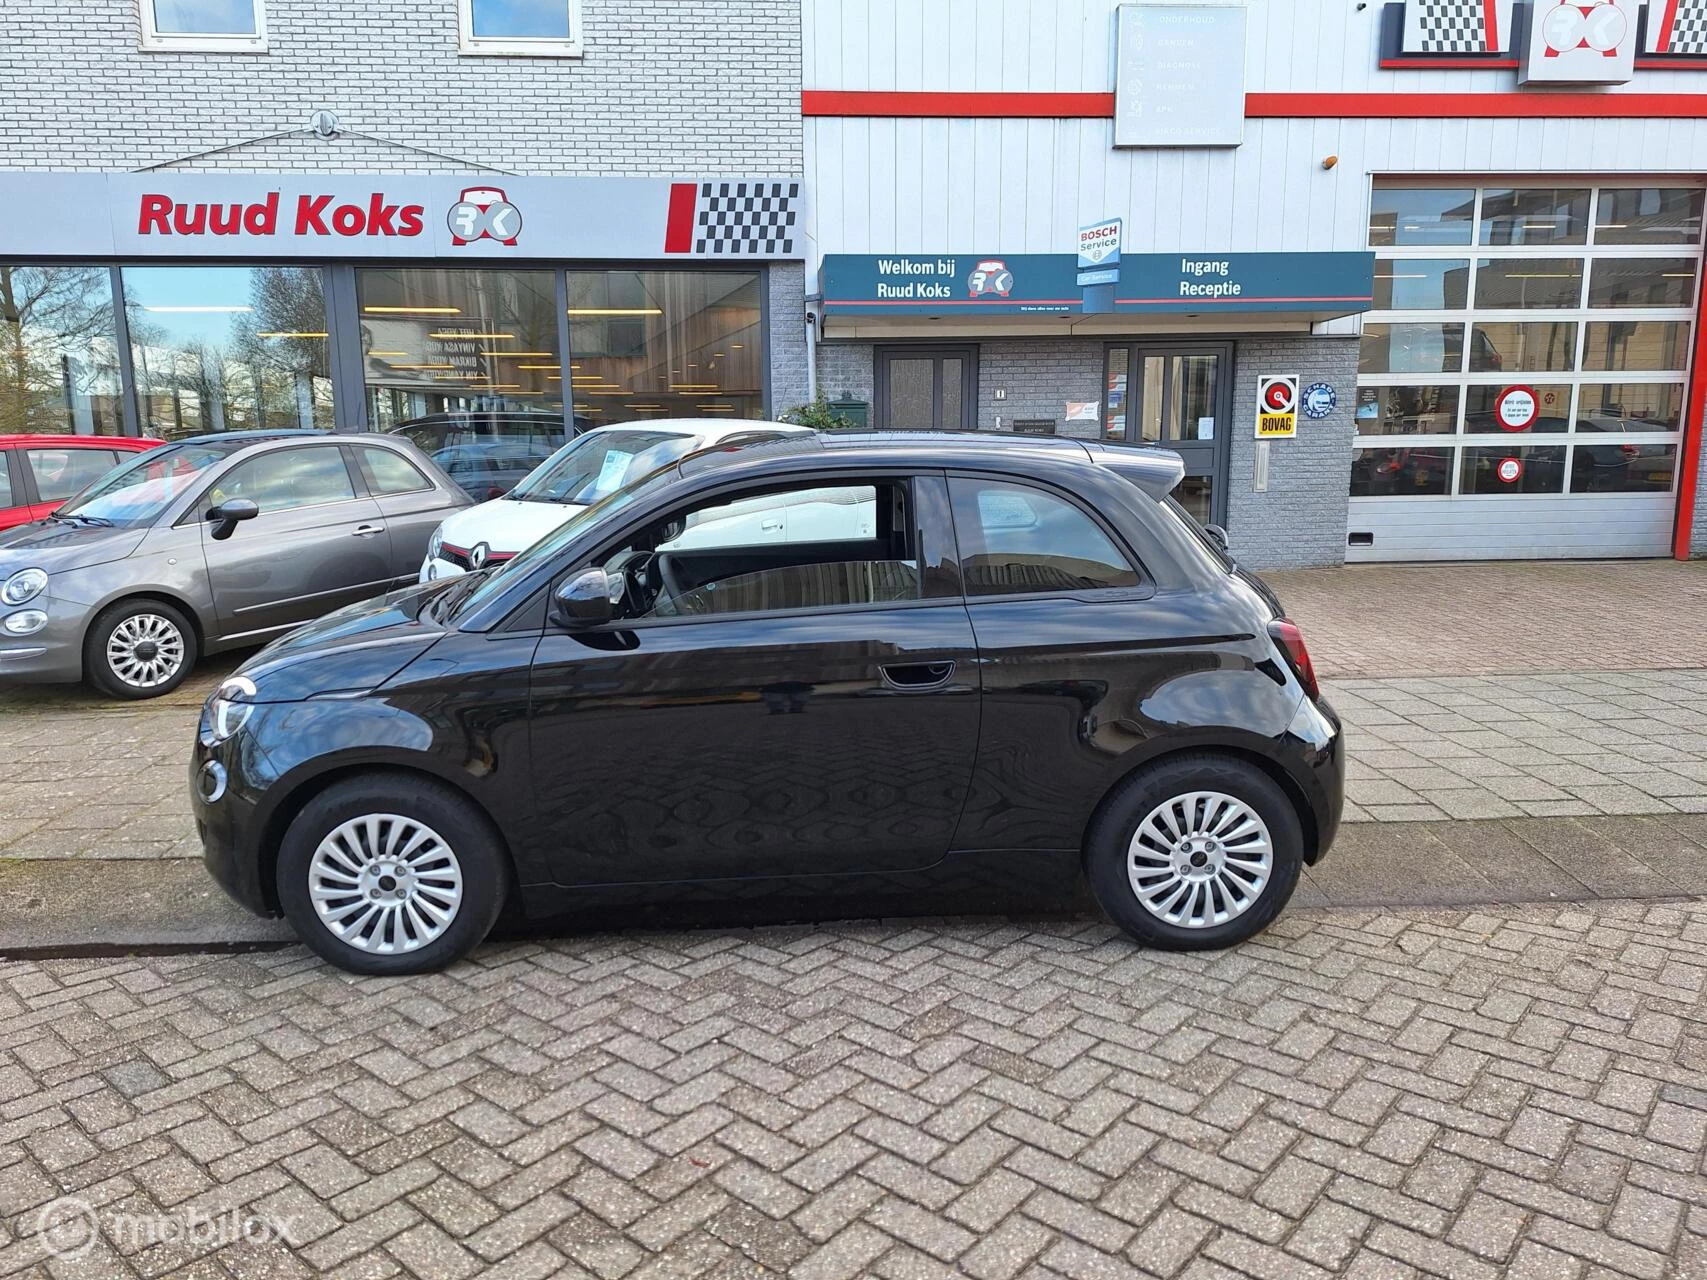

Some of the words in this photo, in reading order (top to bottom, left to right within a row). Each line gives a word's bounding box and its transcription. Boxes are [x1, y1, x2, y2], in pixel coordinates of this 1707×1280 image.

[138, 192, 280, 236] Ruud
[294, 193, 425, 237] Koks
[1080, 225, 1118, 242] BOSCH
[1080, 238, 1118, 252] Service
[878, 259, 935, 275] Welkom
[938, 259, 956, 278] bij
[1181, 258, 1230, 277] Ingang
[877, 282, 914, 298] Ruud
[917, 282, 951, 298] Koks
[1179, 280, 1242, 299] Receptie
[1303, 383, 1336, 398] SCHADE
[1303, 404, 1334, 418] GARANT
[1261, 416, 1293, 432] BOVAG
